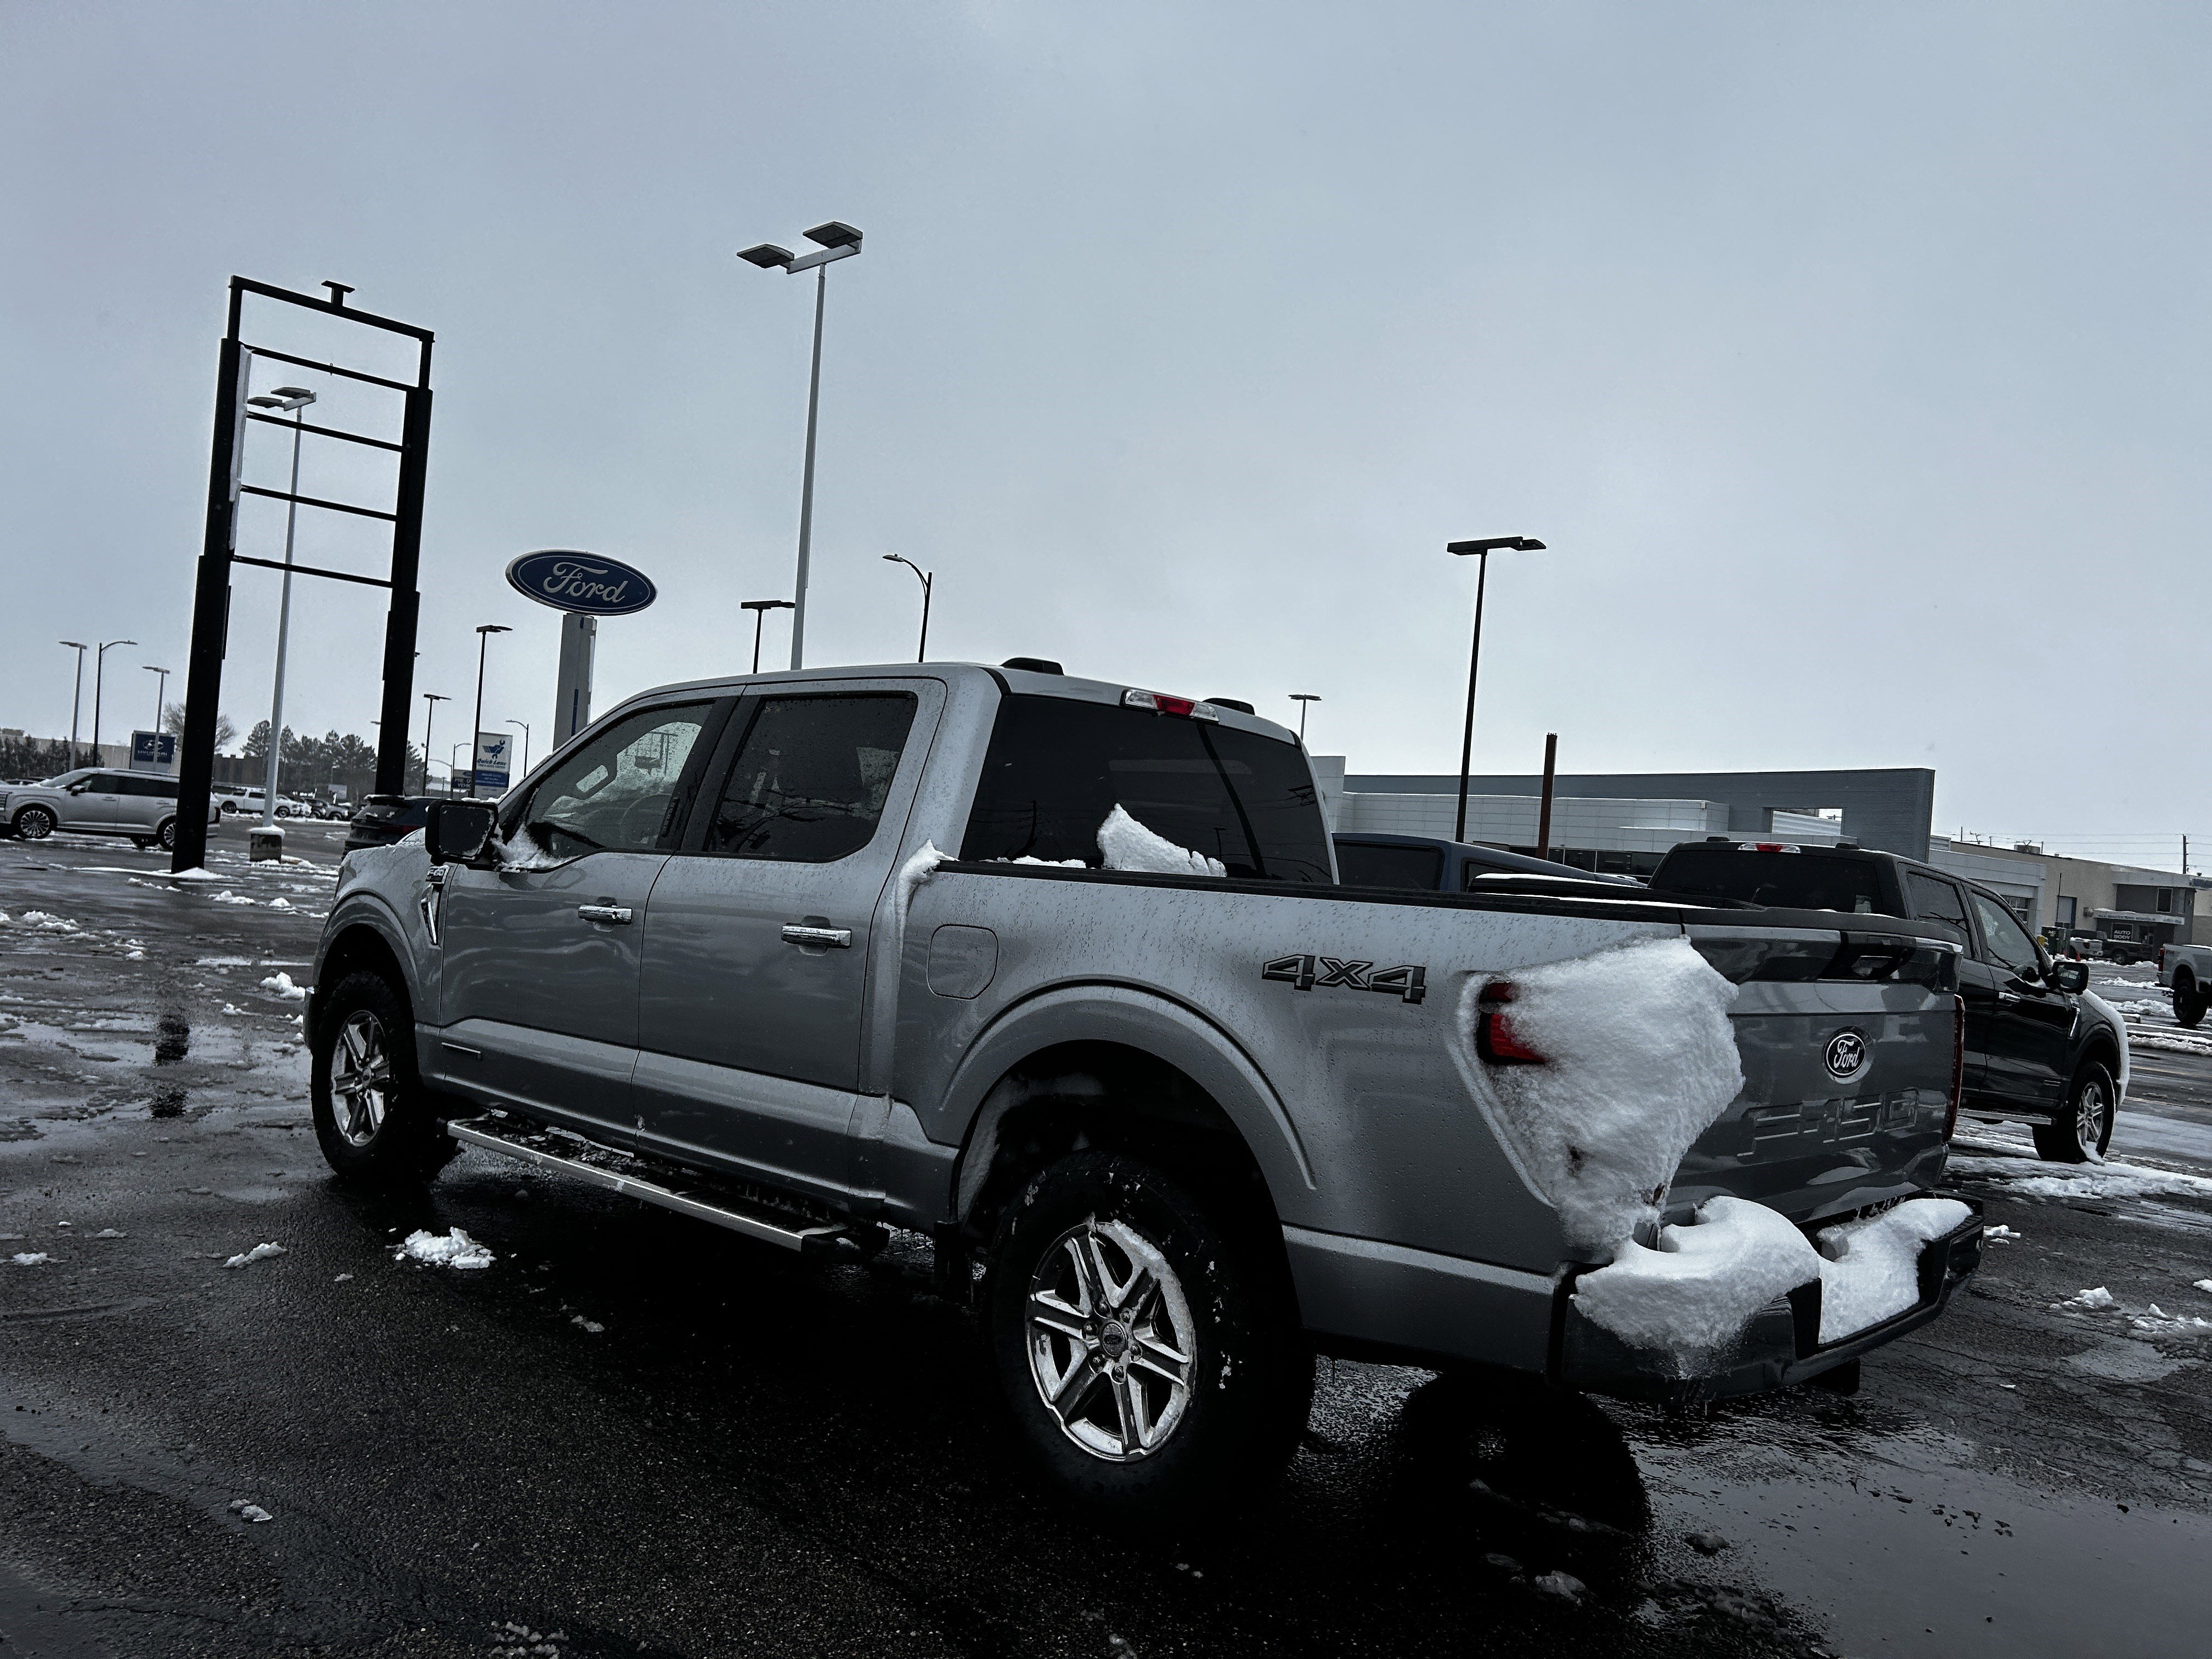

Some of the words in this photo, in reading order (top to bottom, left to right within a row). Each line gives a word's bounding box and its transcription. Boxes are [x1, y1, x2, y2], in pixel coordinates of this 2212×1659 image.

[543, 562, 629, 603] Ford
[1833, 1040, 1860, 1069] Ford
[1737, 1088, 1919, 1156] F-150
